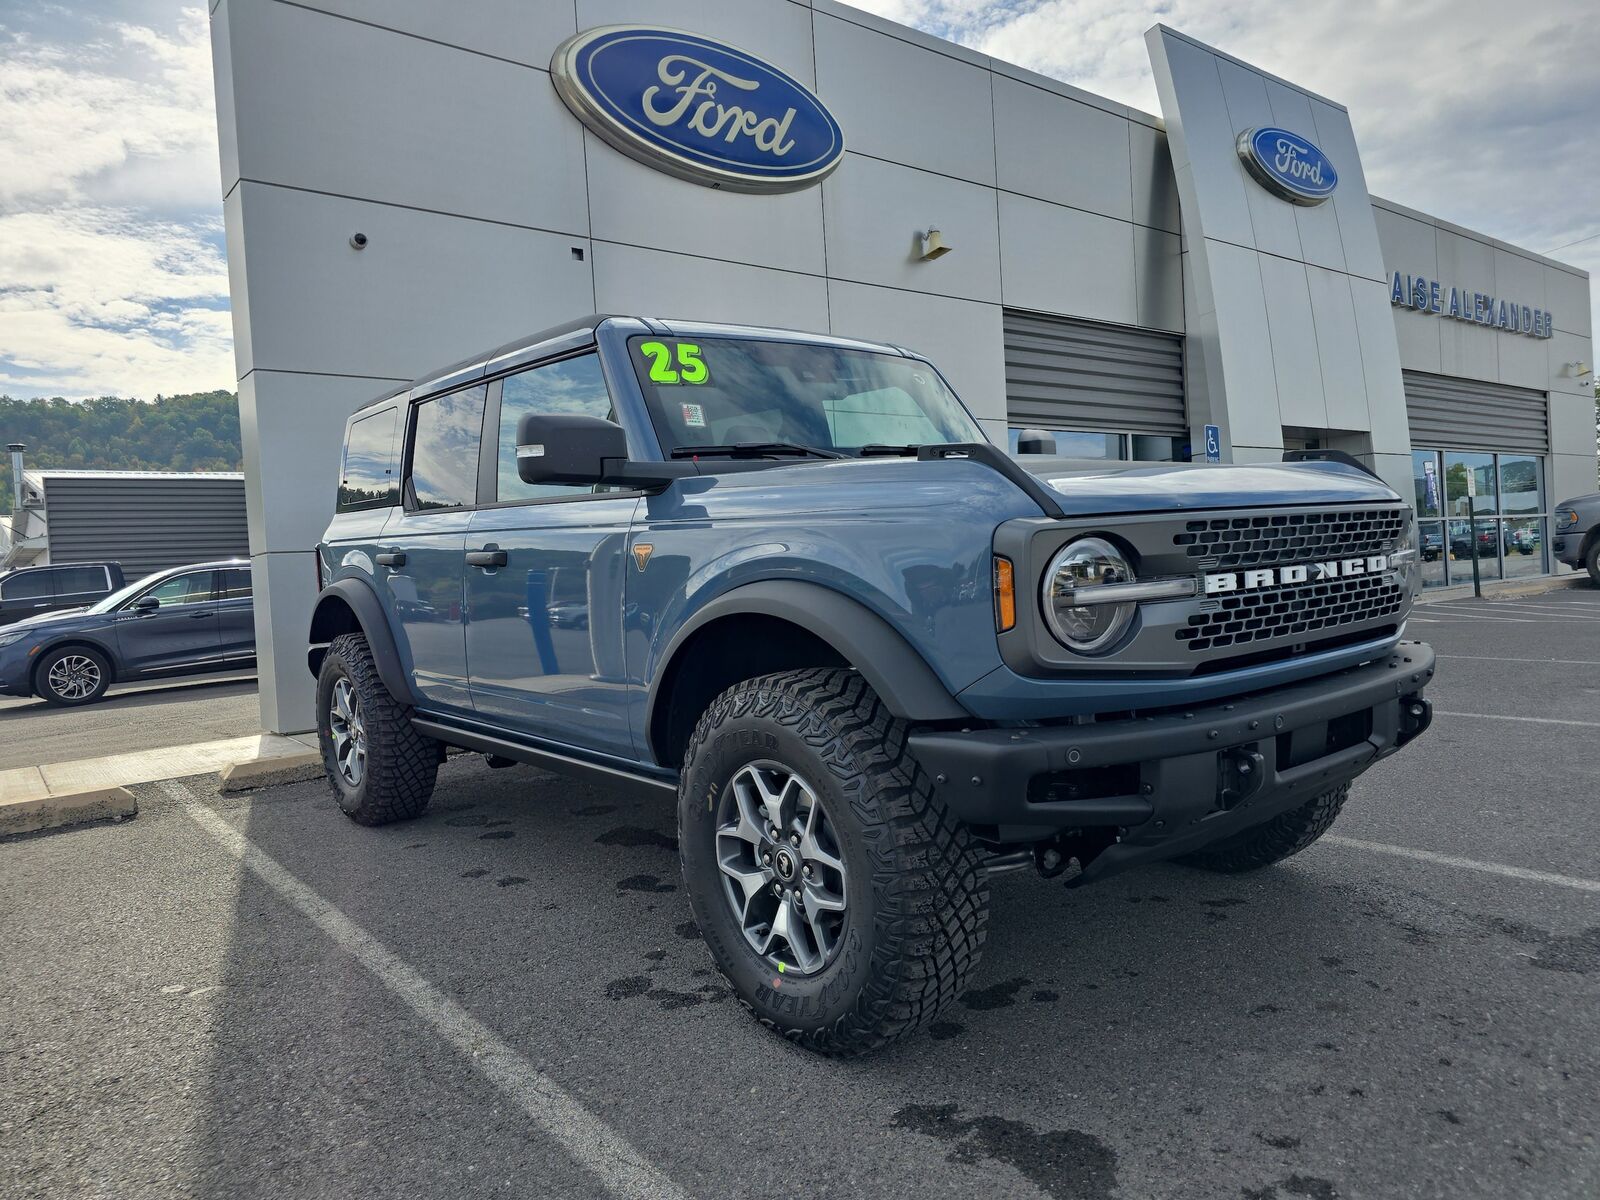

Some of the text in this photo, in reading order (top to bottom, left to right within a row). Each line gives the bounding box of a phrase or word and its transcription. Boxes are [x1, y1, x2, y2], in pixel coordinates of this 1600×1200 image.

[642, 54, 797, 156] Ford
[1274, 138, 1324, 185] Ford
[1449, 287, 1553, 338] ALEXANDER
[640, 342, 709, 385] 25
[1204, 555, 1387, 593] BRONCO
